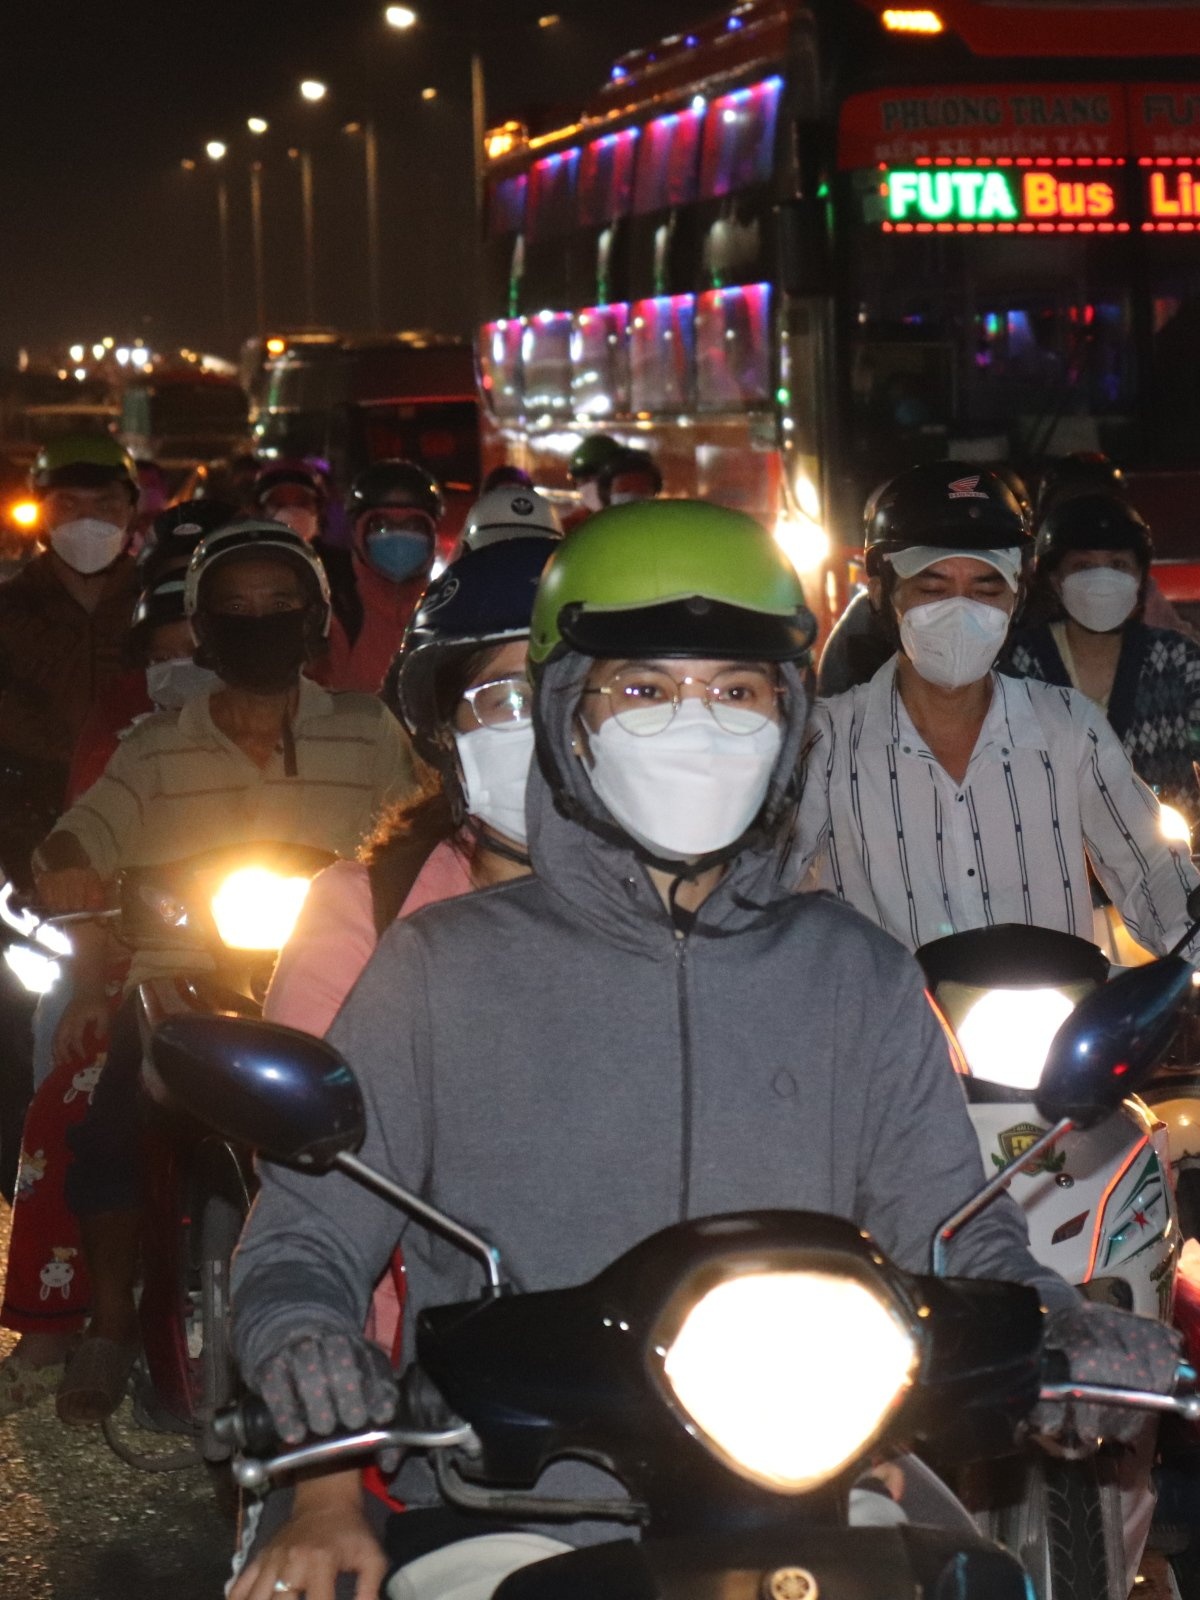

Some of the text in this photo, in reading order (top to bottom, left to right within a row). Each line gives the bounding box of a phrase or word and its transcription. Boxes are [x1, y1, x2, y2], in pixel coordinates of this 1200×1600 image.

[1008, 94, 1112, 125] TRANG
[888, 171, 1018, 219] FUTA
[1024, 172, 1114, 217] Bus
